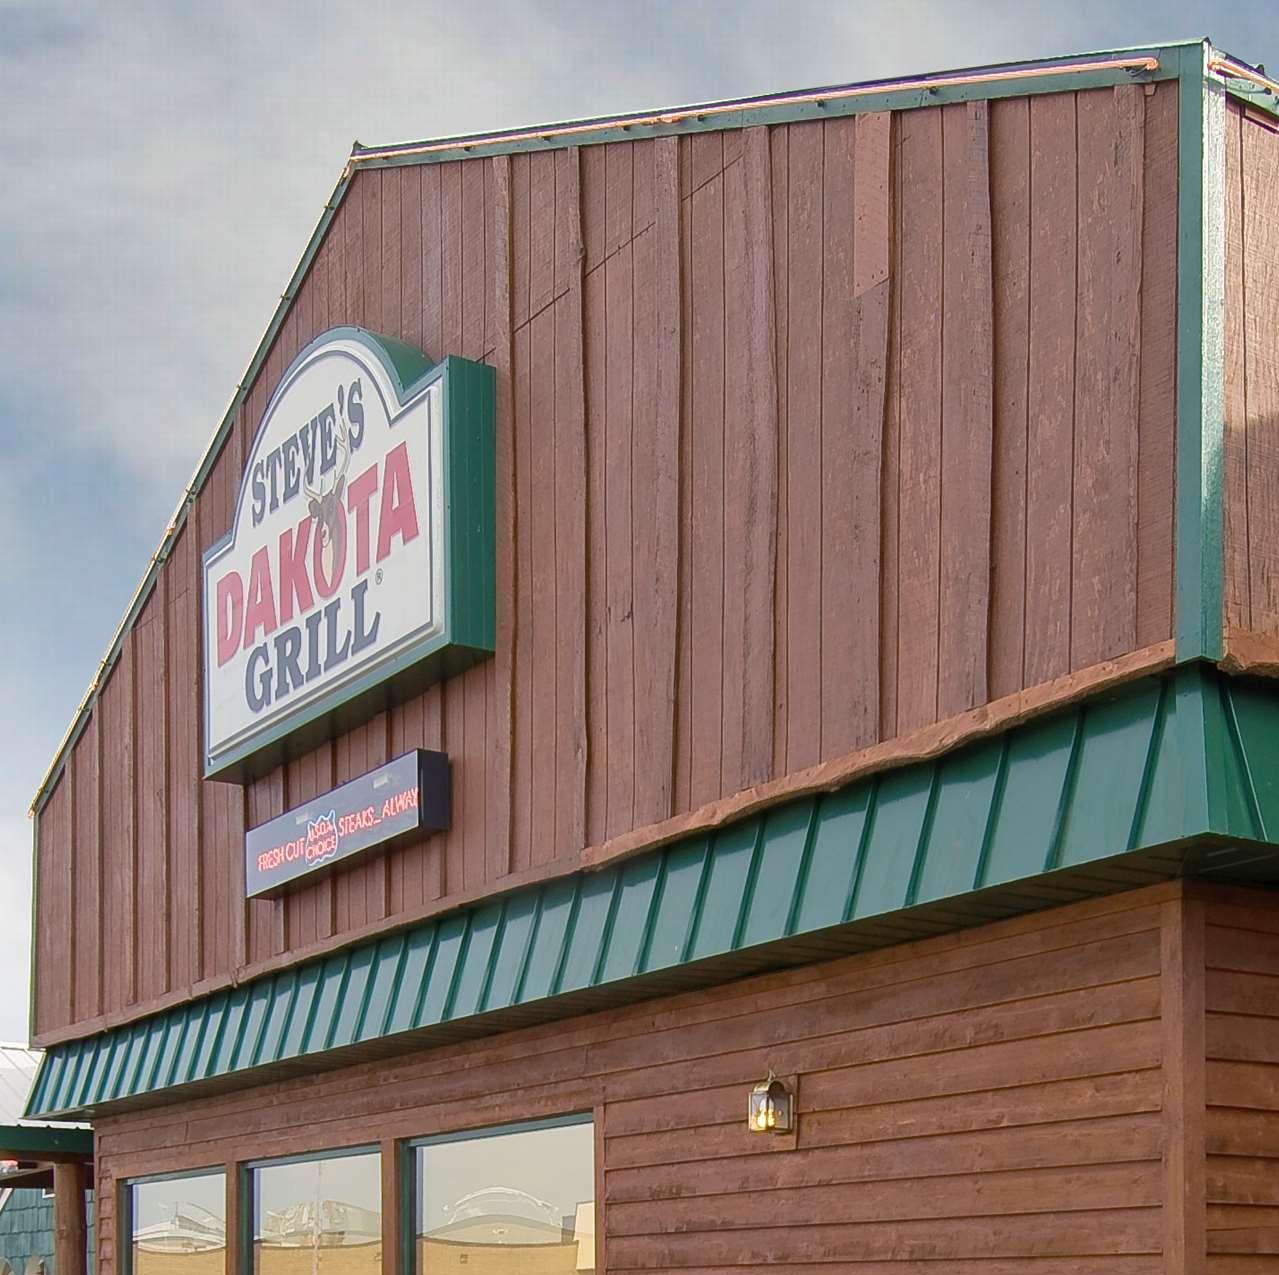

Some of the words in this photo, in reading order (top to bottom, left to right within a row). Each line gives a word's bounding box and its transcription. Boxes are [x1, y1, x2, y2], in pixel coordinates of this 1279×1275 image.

[251, 377, 365, 528] STEVE'S
[217, 440, 419, 668] DAKOTA
[245, 578, 381, 714] GRILL
[258, 847, 284, 872] FRESH
[286, 837, 305, 862] CUT
[306, 835, 336, 861] CHOICE
